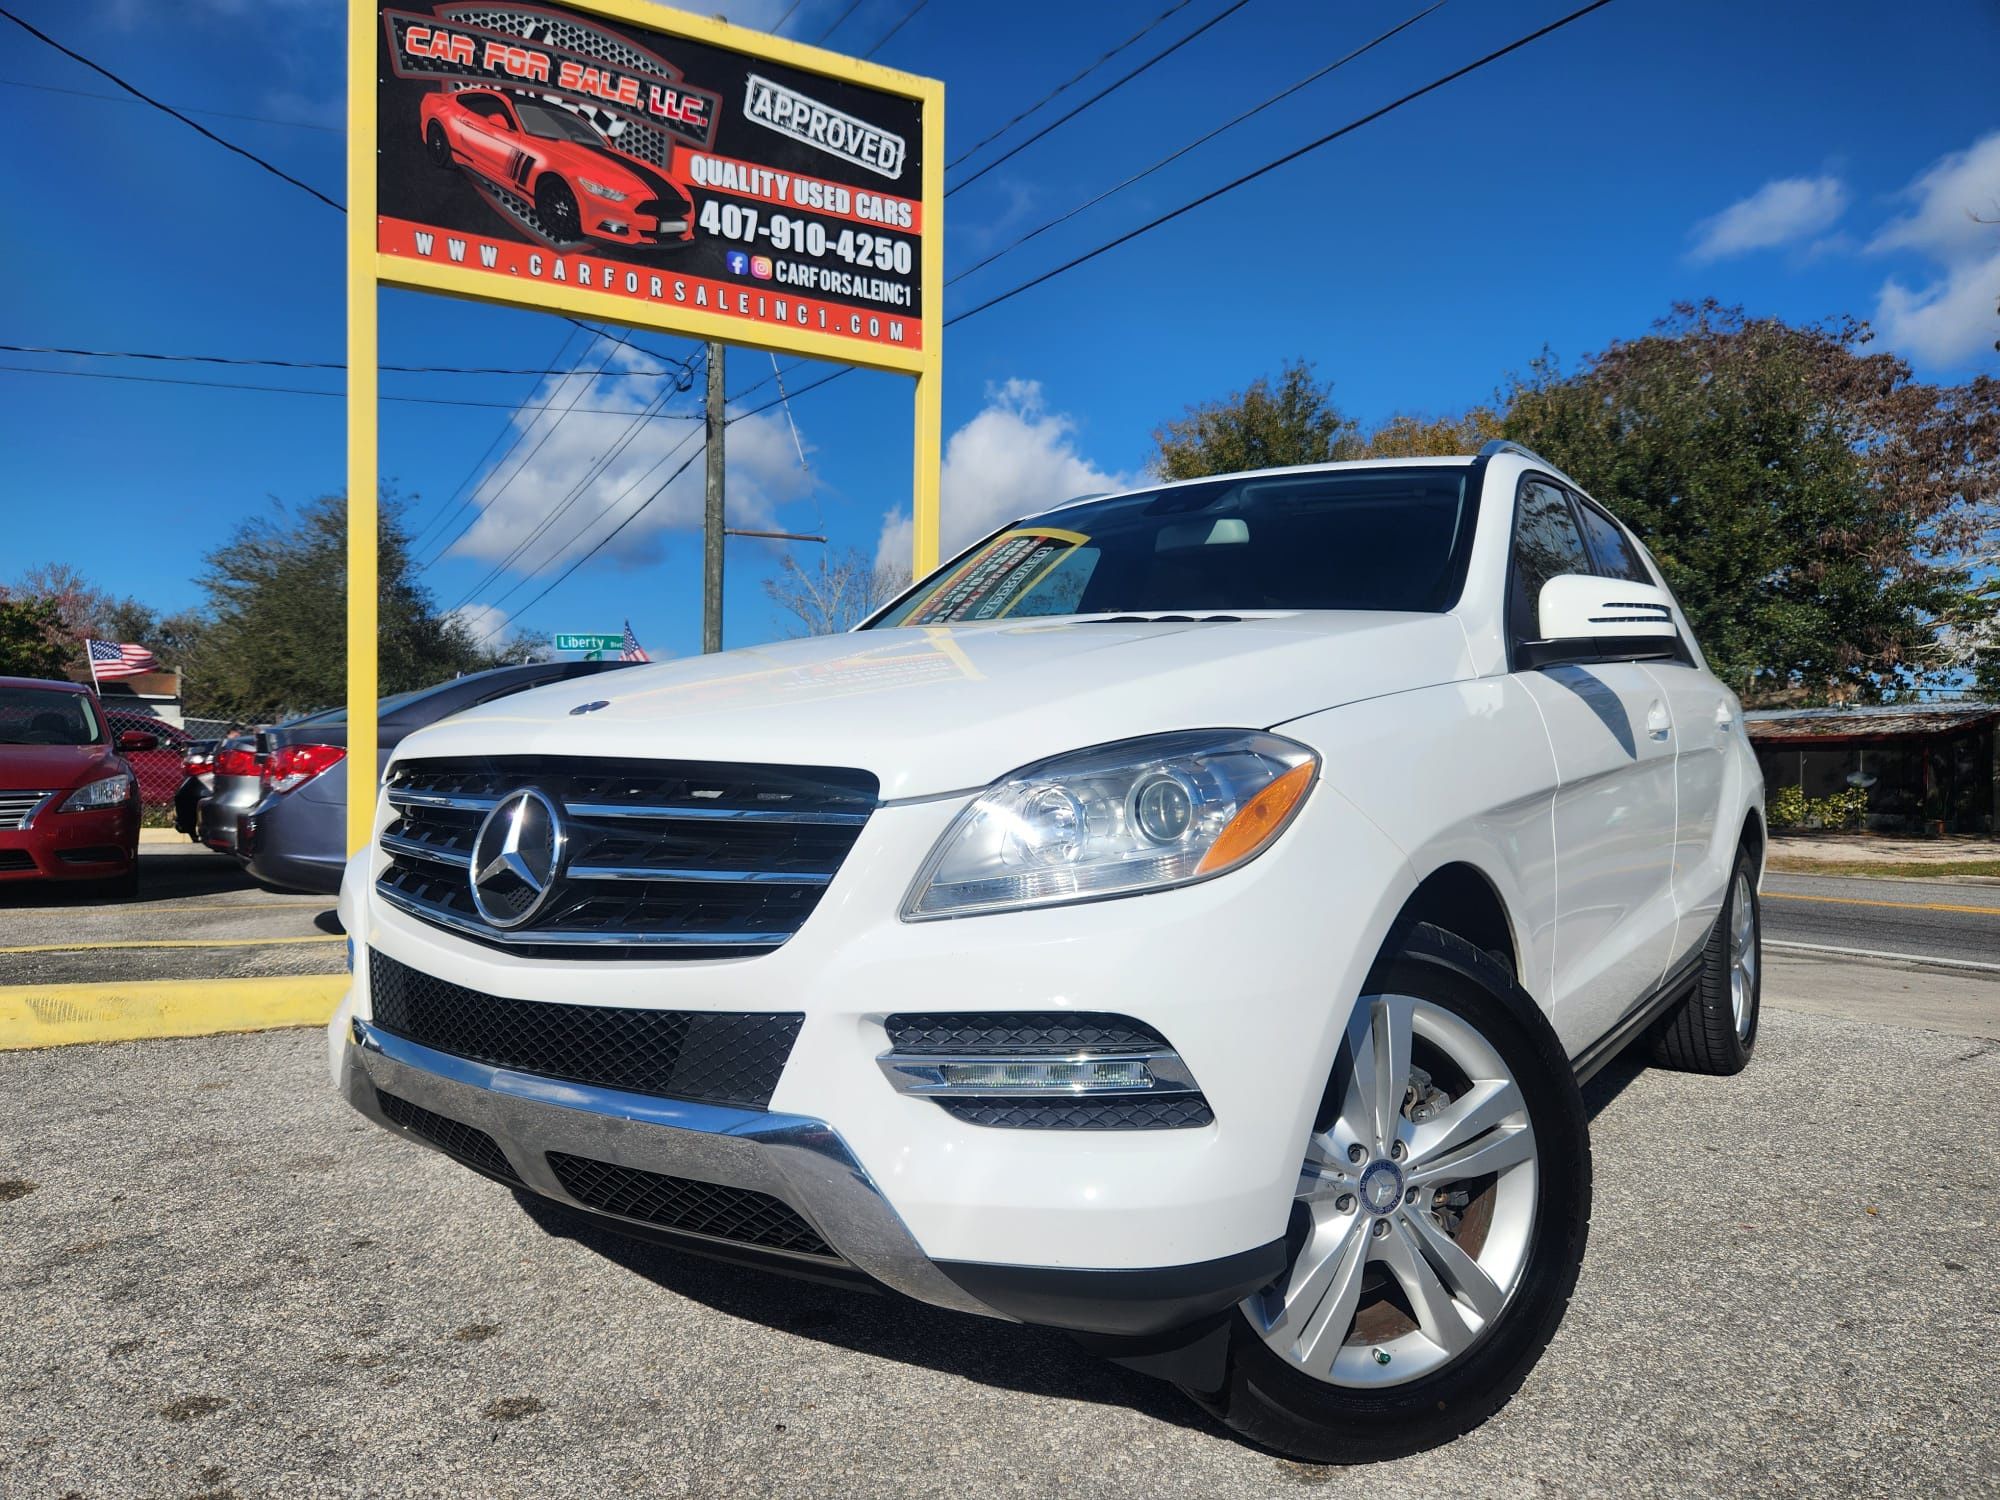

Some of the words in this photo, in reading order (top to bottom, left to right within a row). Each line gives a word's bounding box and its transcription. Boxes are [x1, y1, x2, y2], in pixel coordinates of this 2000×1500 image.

[405, 25, 476, 66] CAR
[483, 41, 551, 82] FOR
[752, 87, 897, 170] APPROVED
[690, 154, 790, 201] QUALITY
[793, 178, 851, 215] USED
[855, 192, 913, 229] CARS
[699, 199, 913, 276] 407-910-4250
[415, 231, 904, 342] WWW.CARFORSALEINC1.COM
[775, 260, 912, 307] CARFORSALEINC1
[561, 637, 604, 649] Liberty
